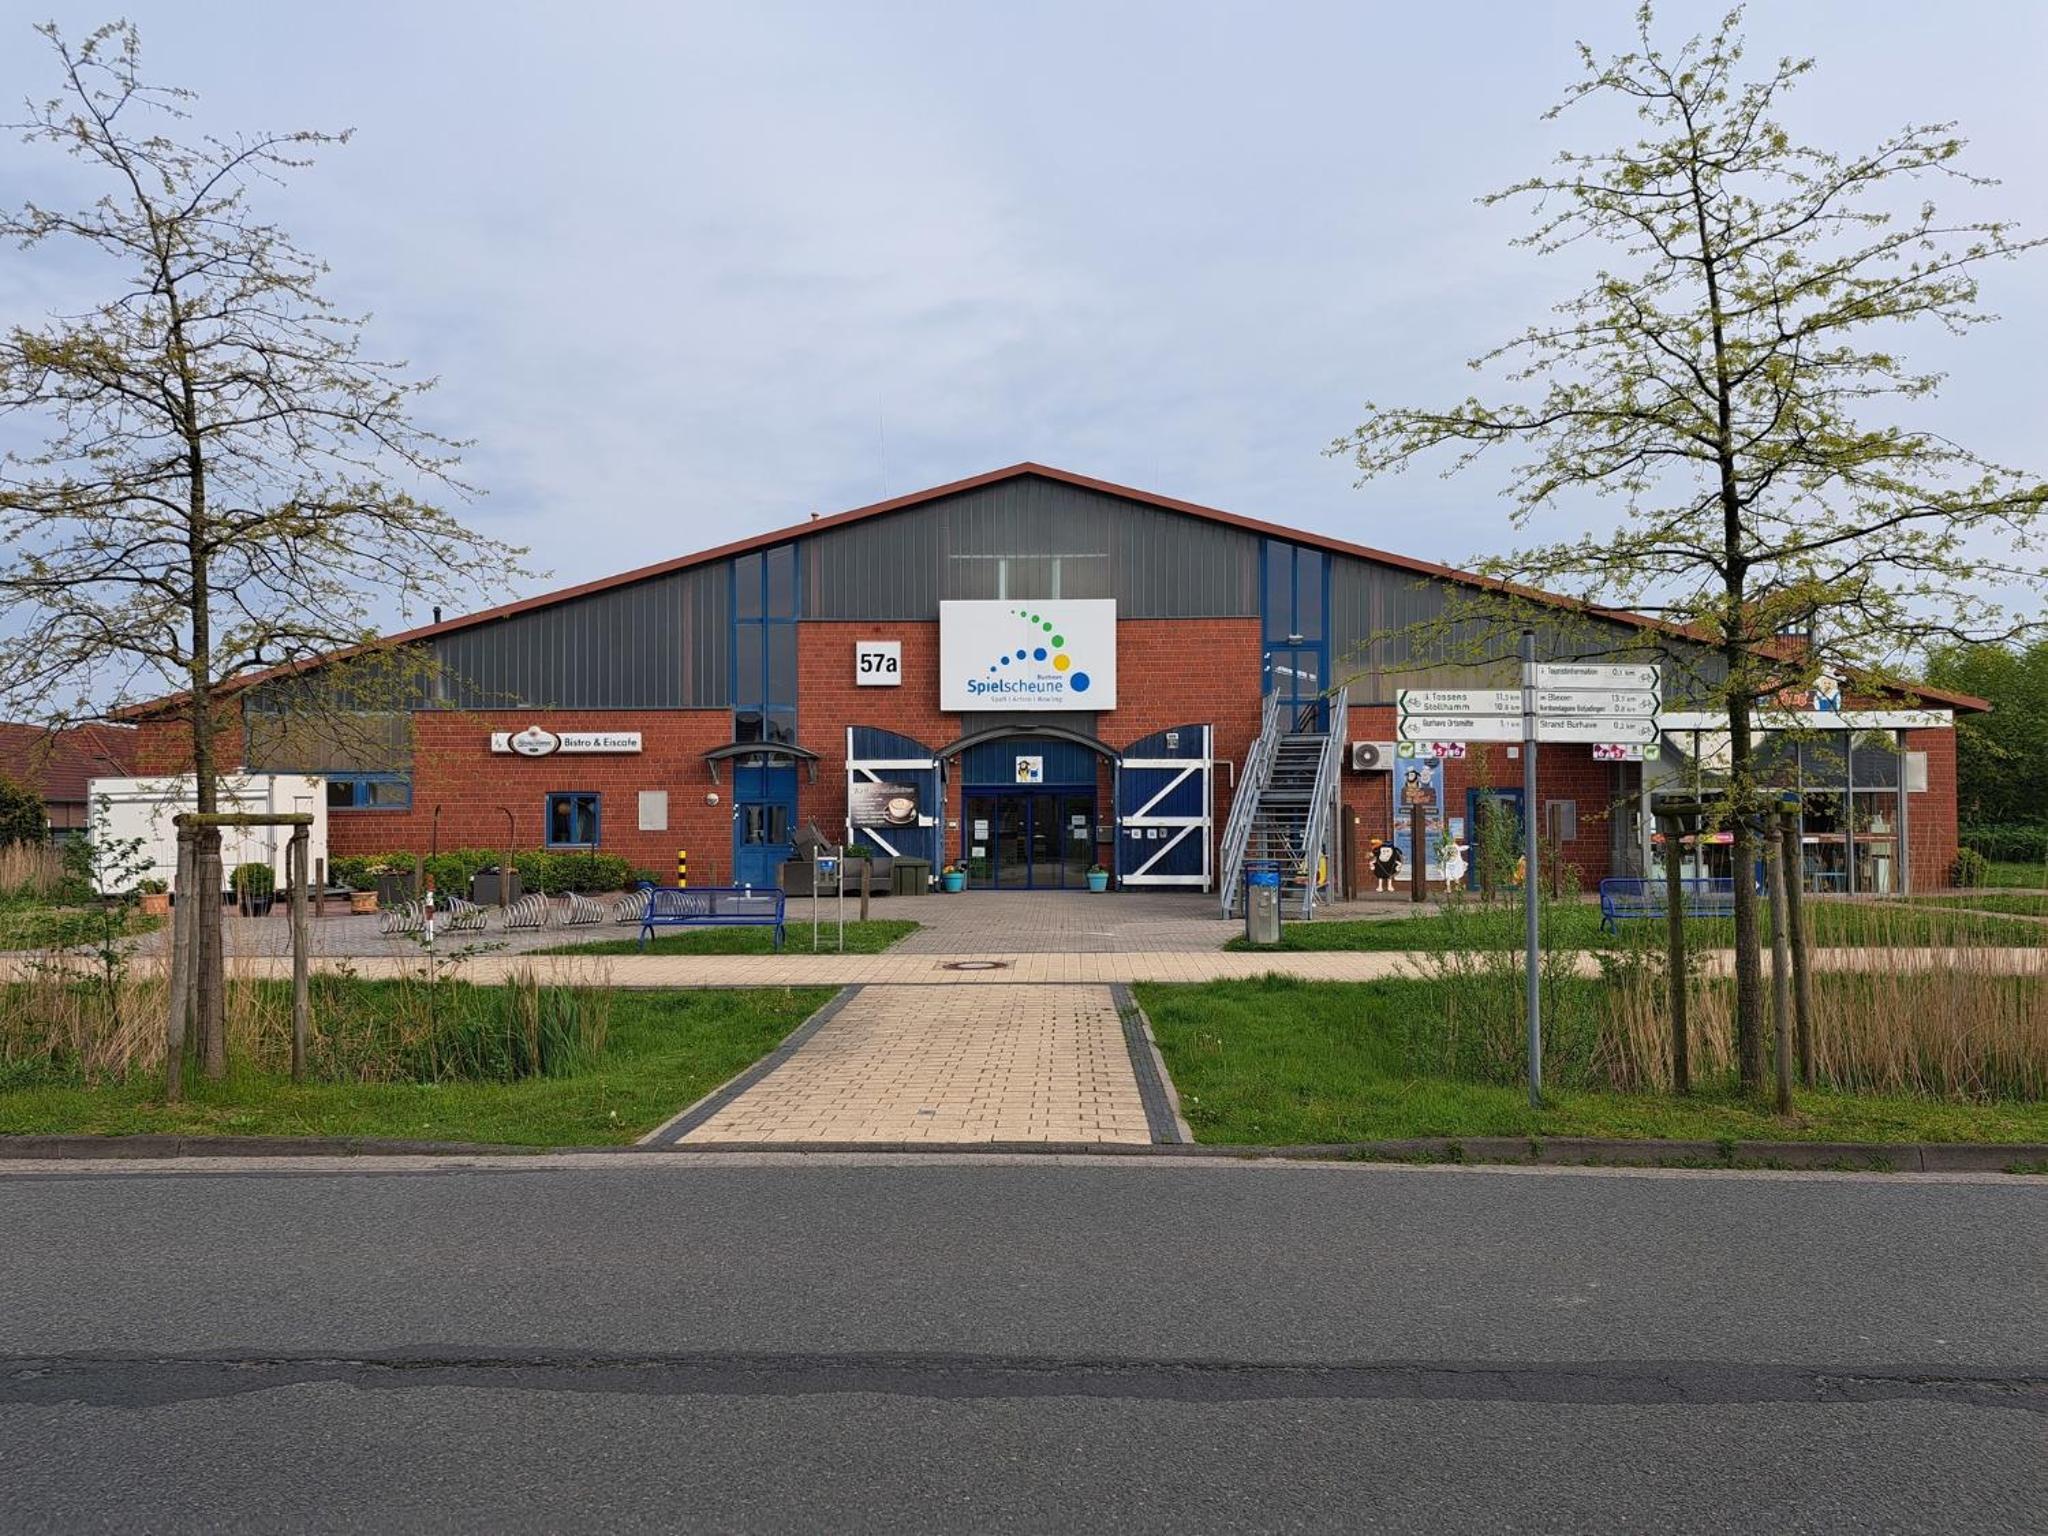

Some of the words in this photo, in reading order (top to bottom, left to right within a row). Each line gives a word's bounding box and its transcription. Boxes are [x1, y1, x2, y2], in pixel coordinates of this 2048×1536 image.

[861, 653, 898, 673] 57a
[1625, 668, 1635, 676] km
[967, 676, 1063, 696] Spielscheune
[1432, 692, 1468, 701] Tossens
[1423, 702, 1470, 711] Stollhamm
[1539, 720, 1565, 729] Strand
[1566, 720, 1598, 729] Burhave
[1626, 721, 1636, 729] km
[564, 737, 592, 748] Bistro
[593, 737, 602, 747] &
